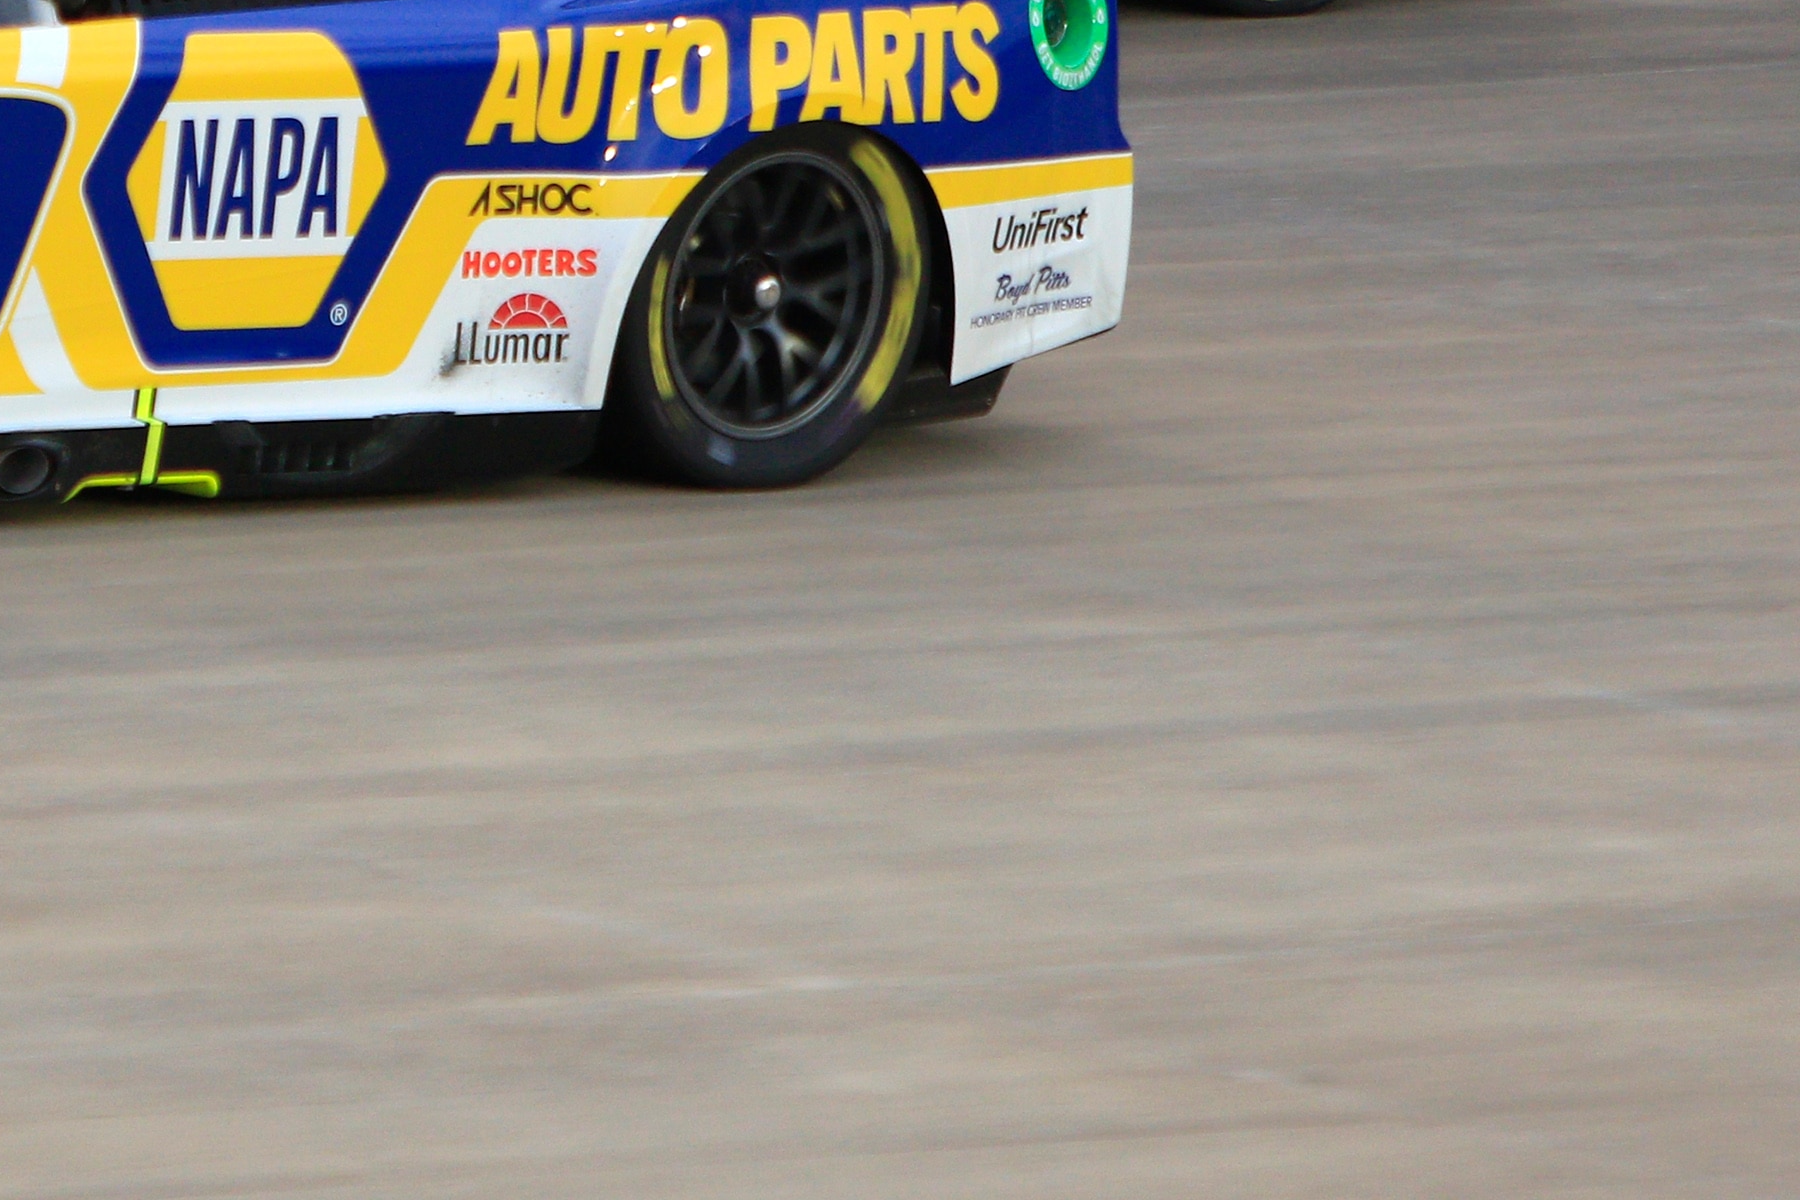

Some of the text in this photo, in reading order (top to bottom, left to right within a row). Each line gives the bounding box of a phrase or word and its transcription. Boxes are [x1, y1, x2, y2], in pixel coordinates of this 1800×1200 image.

[464, 0, 1000, 147] AUTO PARTS
[167, 115, 340, 243] NAPA
[467, 181, 594, 218] ASHOC
[992, 206, 1089, 254] UniFirst
[460, 248, 599, 280] HOOTERS
[994, 274, 1035, 306] Boyd
[1052, 296, 1093, 312] MEMBER
